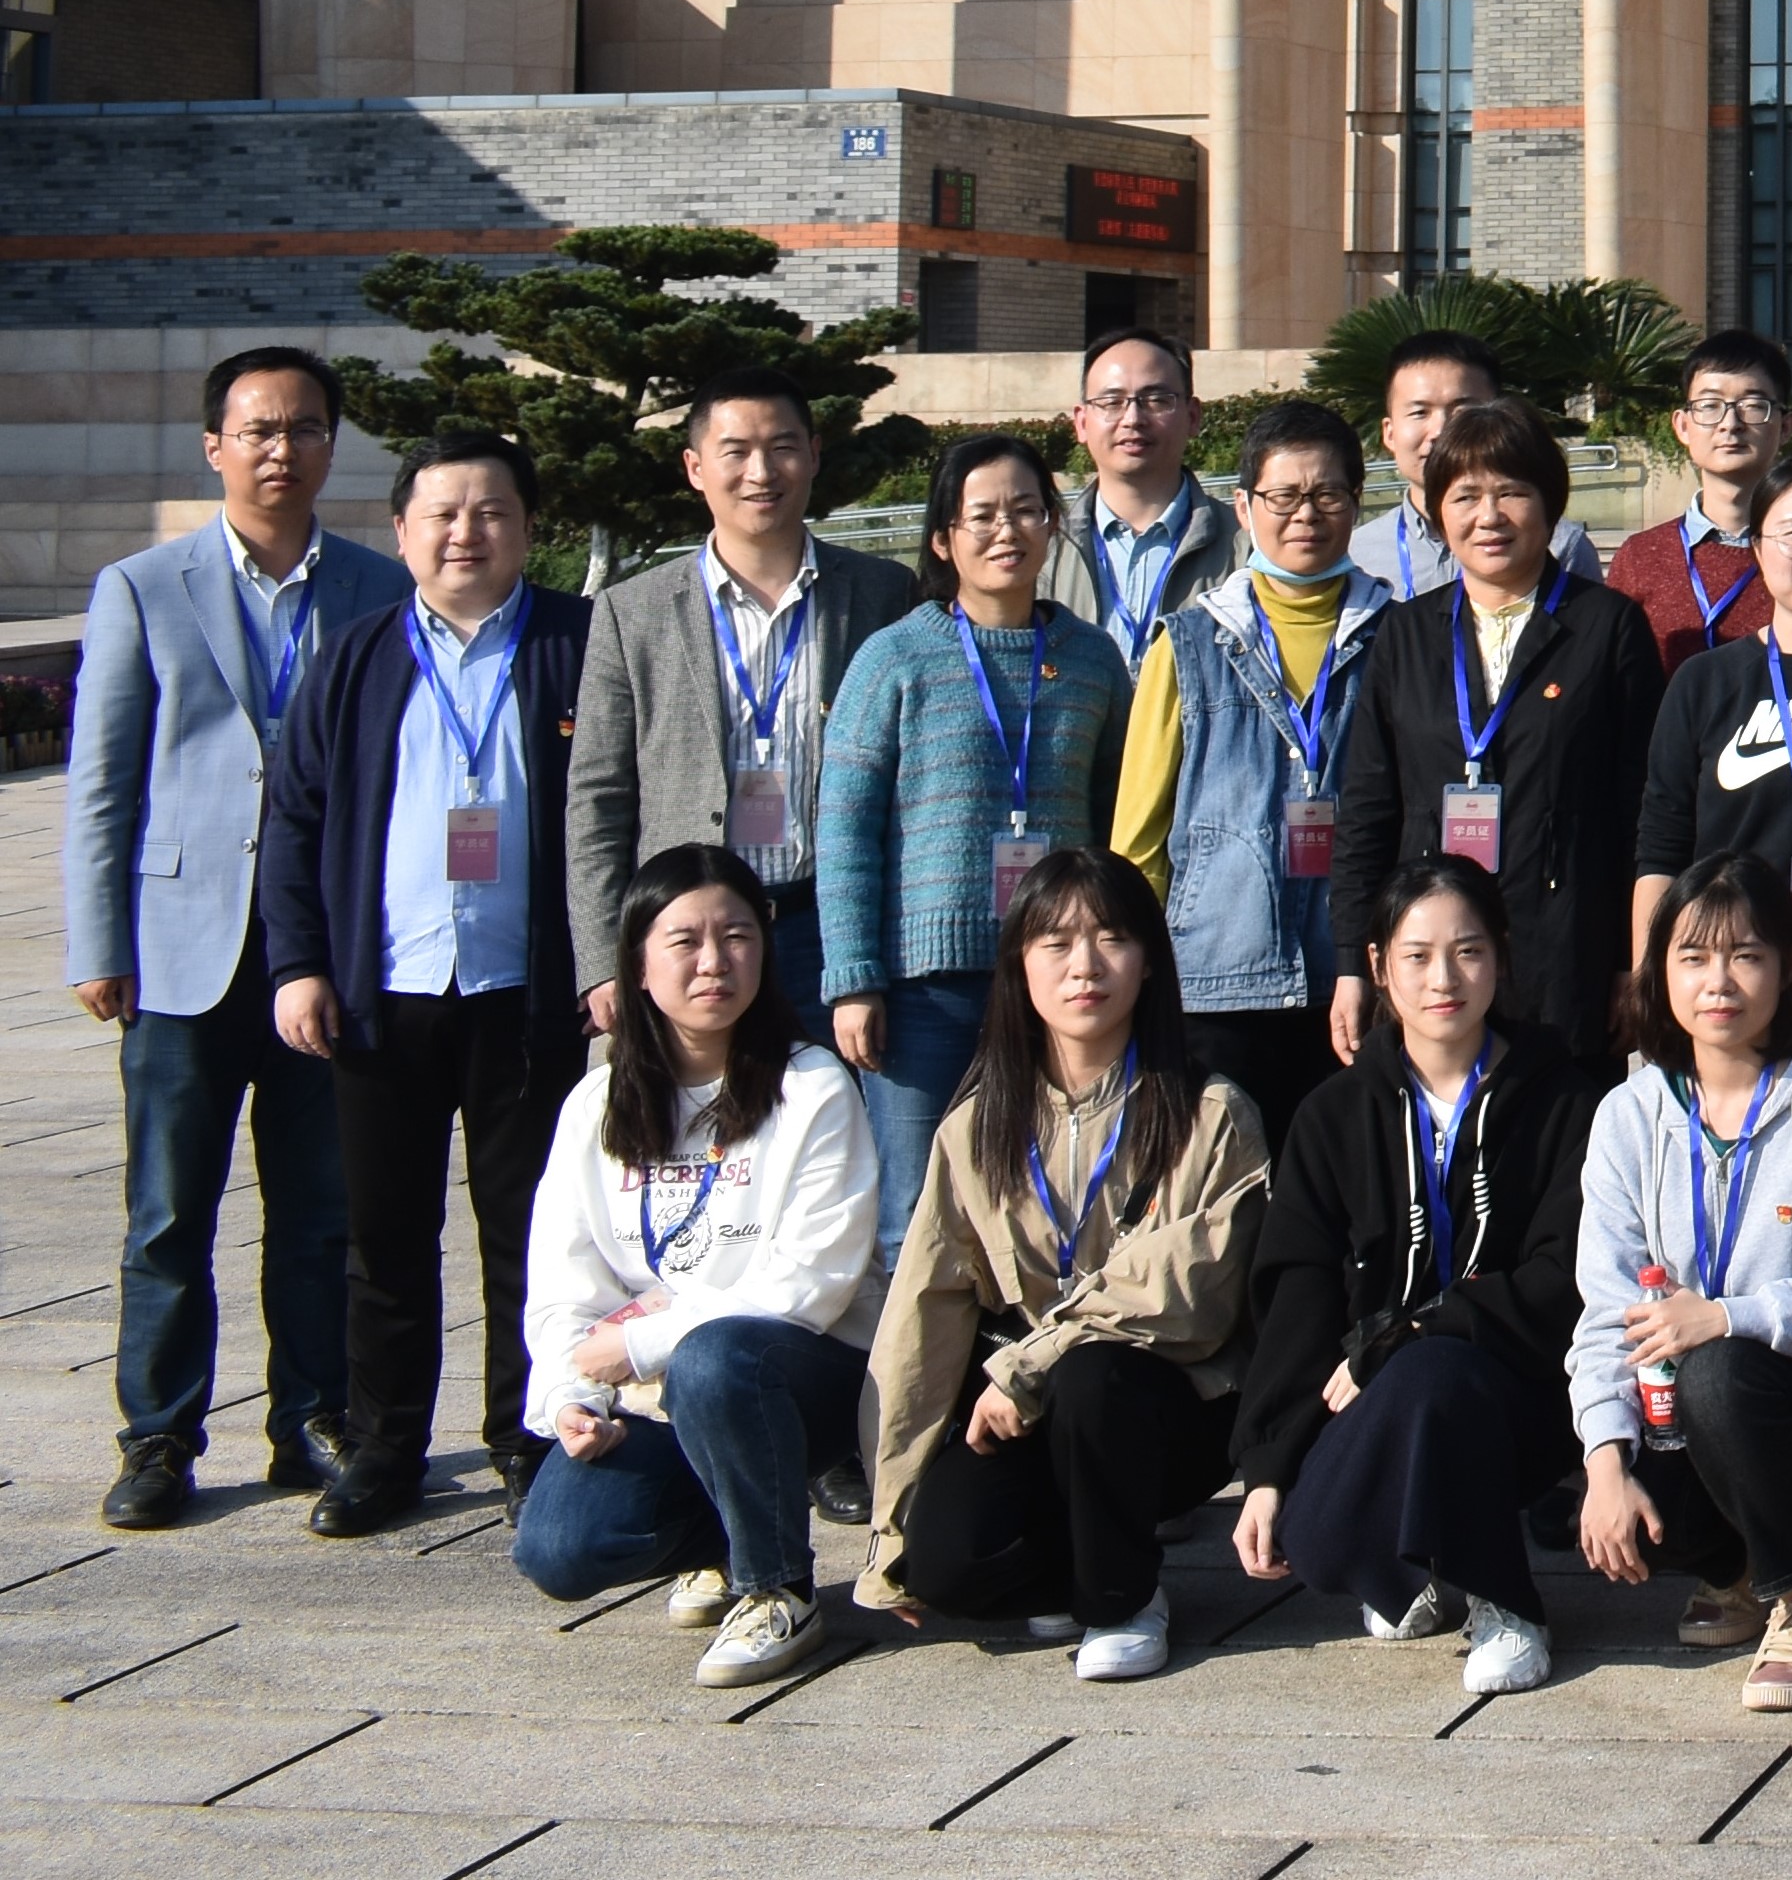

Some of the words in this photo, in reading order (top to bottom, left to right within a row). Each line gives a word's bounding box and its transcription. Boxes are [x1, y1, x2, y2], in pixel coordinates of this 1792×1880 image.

[852, 136, 876, 151] 186
[1453, 825, 1490, 837] 学员证
